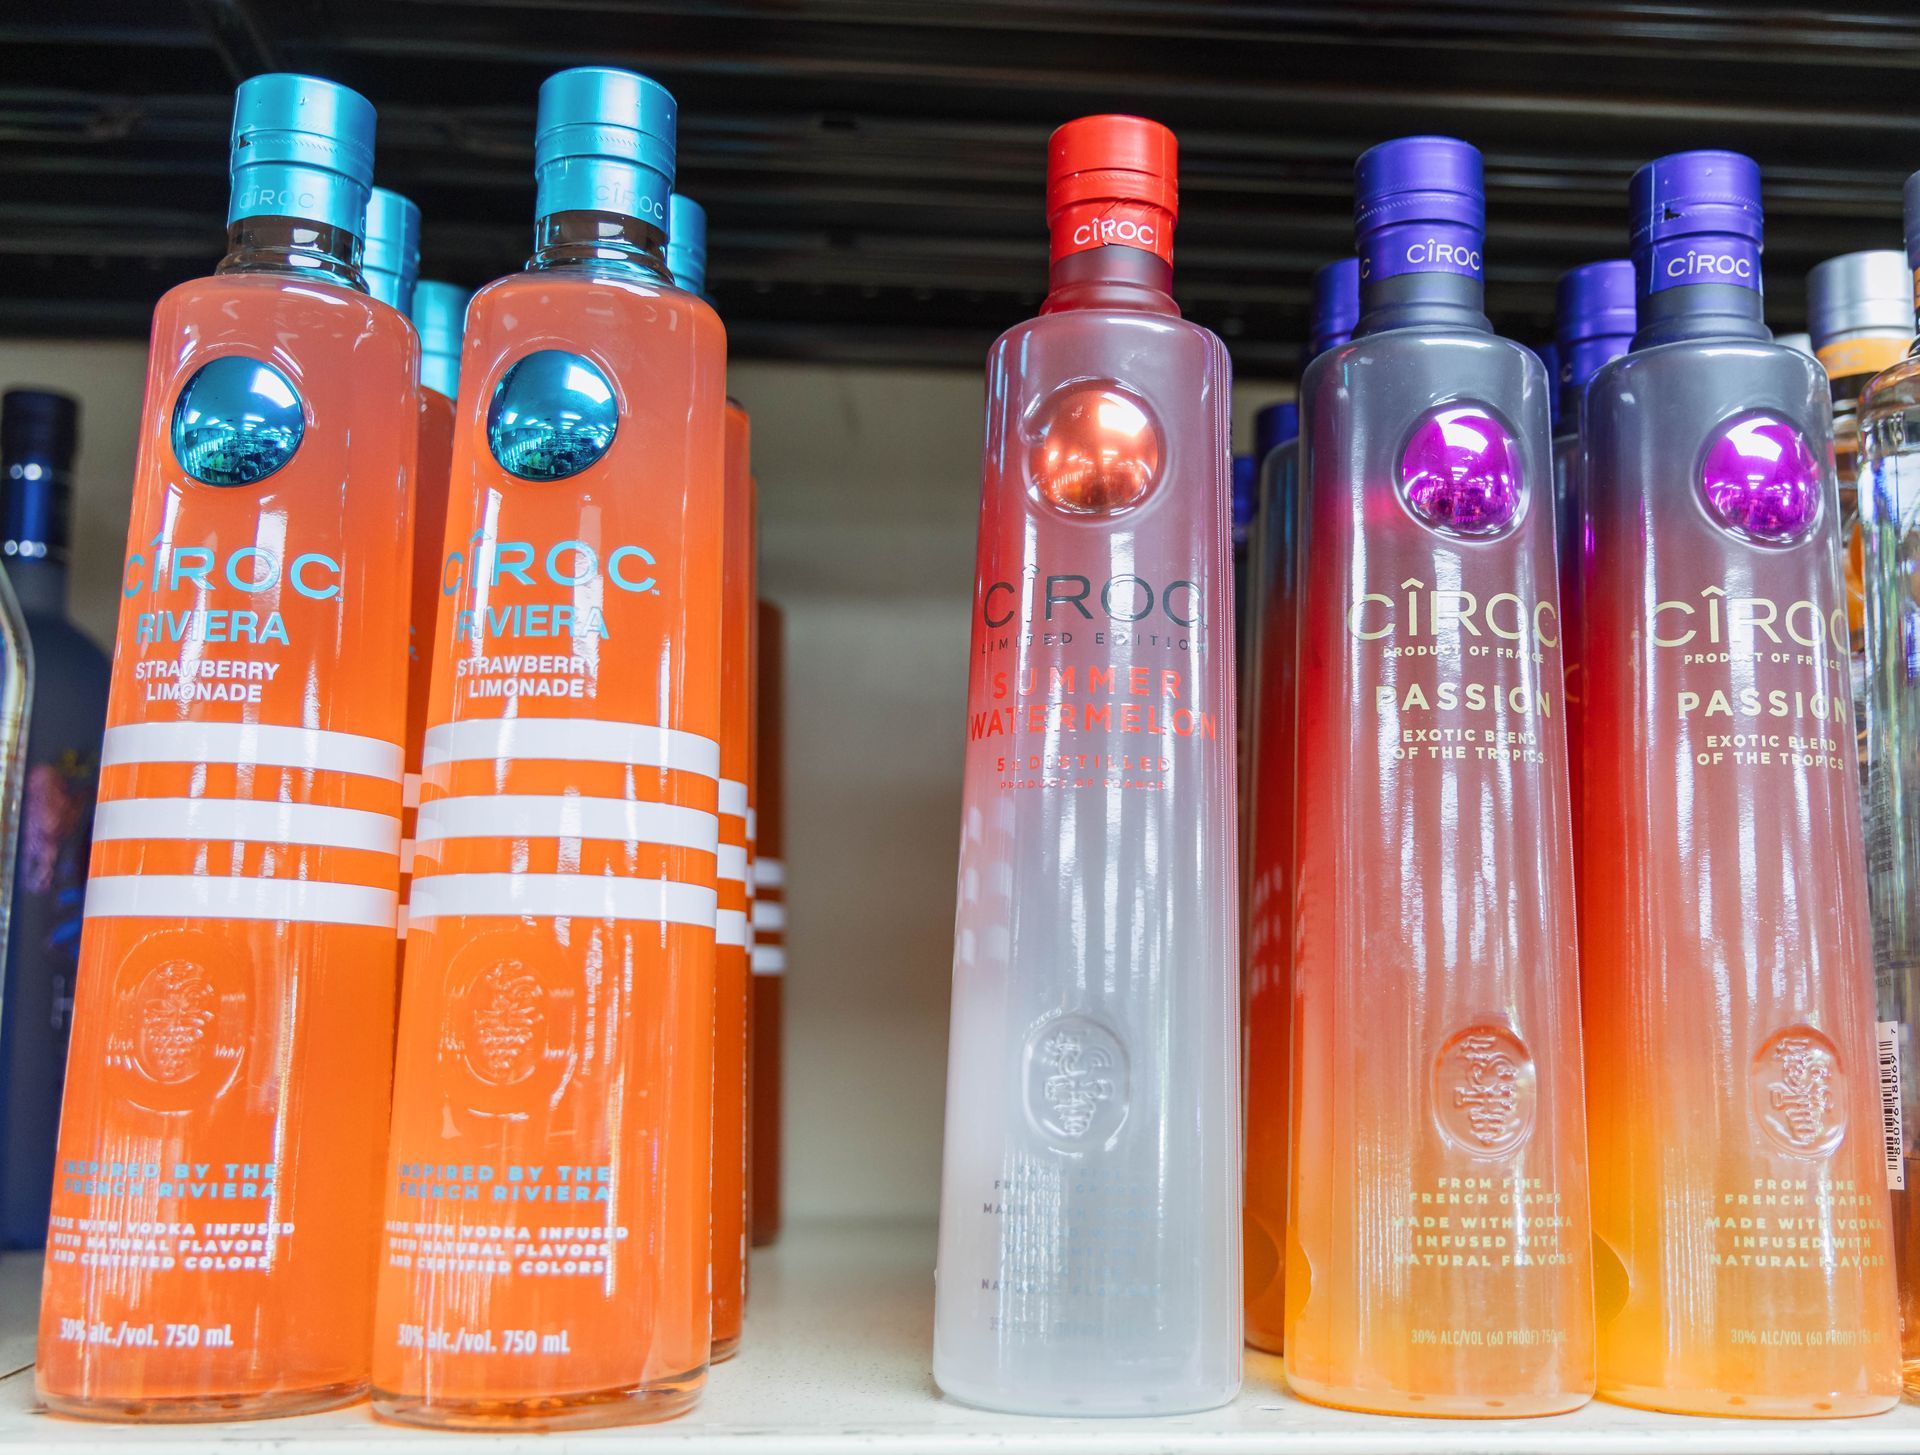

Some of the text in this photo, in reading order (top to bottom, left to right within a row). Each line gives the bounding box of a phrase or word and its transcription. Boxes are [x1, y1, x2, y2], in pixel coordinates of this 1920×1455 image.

[1073, 217, 1154, 245] CÎROC
[1406, 238, 1480, 271] CÎROC
[1667, 250, 1751, 278] CÎROC
[123, 531, 340, 600] CÎROC
[1348, 577, 1558, 648] CÎROC
[136, 610, 290, 646] RIVIERA
[1469, 646, 1489, 657] OF
[457, 655, 600, 678] STRAWBERRY
[1771, 652, 1790, 664] OF
[1797, 654, 1841, 672] FRNCE
[135, 660, 280, 681] STRAWBERRY
[469, 678, 584, 698] LIMONADE
[993, 664, 1182, 699] SUMMER
[147, 683, 263, 703] LIMONADE
[1376, 682, 1551, 719] PASSION
[1678, 689, 1848, 725] PASSION
[970, 701, 1217, 742] WATERMELON
[1403, 729, 1476, 743] EXOTIC
[1706, 735, 1780, 748] EXOTIC
[1394, 746, 1418, 760] OF
[1428, 746, 1466, 760] THE
[1697, 752, 1724, 766] OF
[1733, 752, 1771, 765] THE
[174, 1164, 210, 1180] BY
[225, 1164, 277, 1180] THE
[508, 1166, 543, 1182] BY
[558, 1166, 611, 1182] THE
[159, 1182, 276, 1199] RIVIERA
[1438, 1177, 1492, 1189] FROM
[1754, 1178, 1807, 1190] FROM
[493, 1185, 610, 1201] RIVIERA
[1408, 1192, 1489, 1205] FRENCH
[1725, 1194, 1805, 1206] FRENCH
[126, 1222, 196, 1236] VODKA
[1461, 1217, 1513, 1229] WITH
[1704, 1216, 1767, 1229] MADE
[462, 1226, 531, 1240] VODKA
[178, 1240, 276, 1253] FLAVORS
[1417, 1235, 1507, 1248] INFUSED
[1734, 1235, 1826, 1249] INFUSED
[514, 1243, 611, 1257] FLAVORS
[184, 1256, 270, 1270] COLORS
[520, 1260, 605, 1274] COLORS
[1709, 1254, 1809, 1268] NATURAL
[60, 1317, 86, 1341] 30%
[90, 1321, 159, 1347] alc./vol.
[165, 1324, 199, 1347] 750
[396, 1323, 424, 1348] 30%
[503, 1330, 537, 1353] 750
[1411, 1329, 1437, 1345] 30%
[1441, 1329, 1483, 1346] ALC/VOL
[1486, 1330, 1503, 1346] (60
[1731, 1329, 1756, 1345] 30%
[1760, 1329, 1802, 1346] ALC/VOL
[1806, 1330, 1823, 1347] (60
